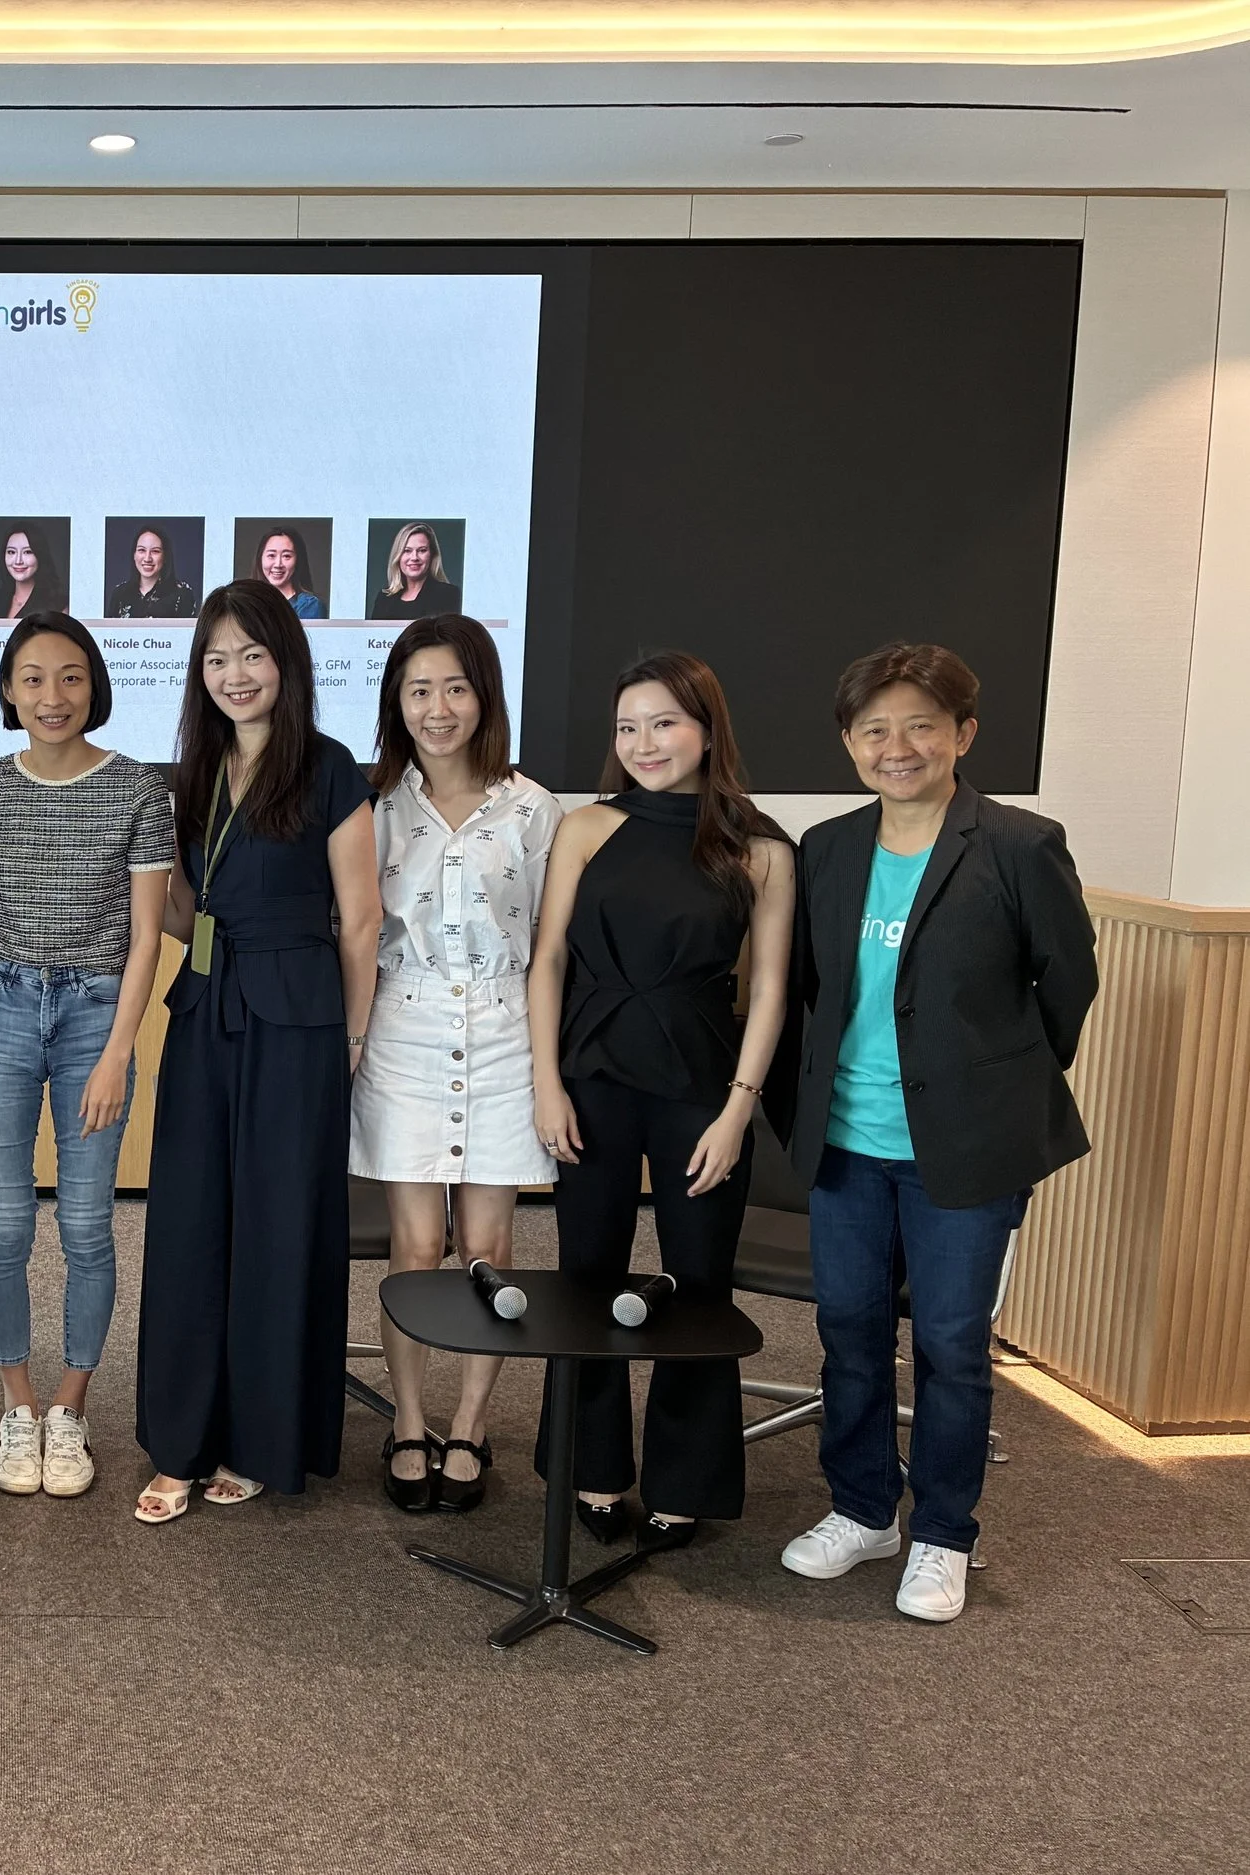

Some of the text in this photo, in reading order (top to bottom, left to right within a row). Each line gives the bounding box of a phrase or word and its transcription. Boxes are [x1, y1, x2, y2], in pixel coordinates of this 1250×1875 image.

[103, 638, 172, 649] Nicole Chua
[367, 639, 394, 649] Kate
[325, 660, 351, 670] GFM
[110, 677, 157, 688] orporate
[315, 676, 347, 687] lation
